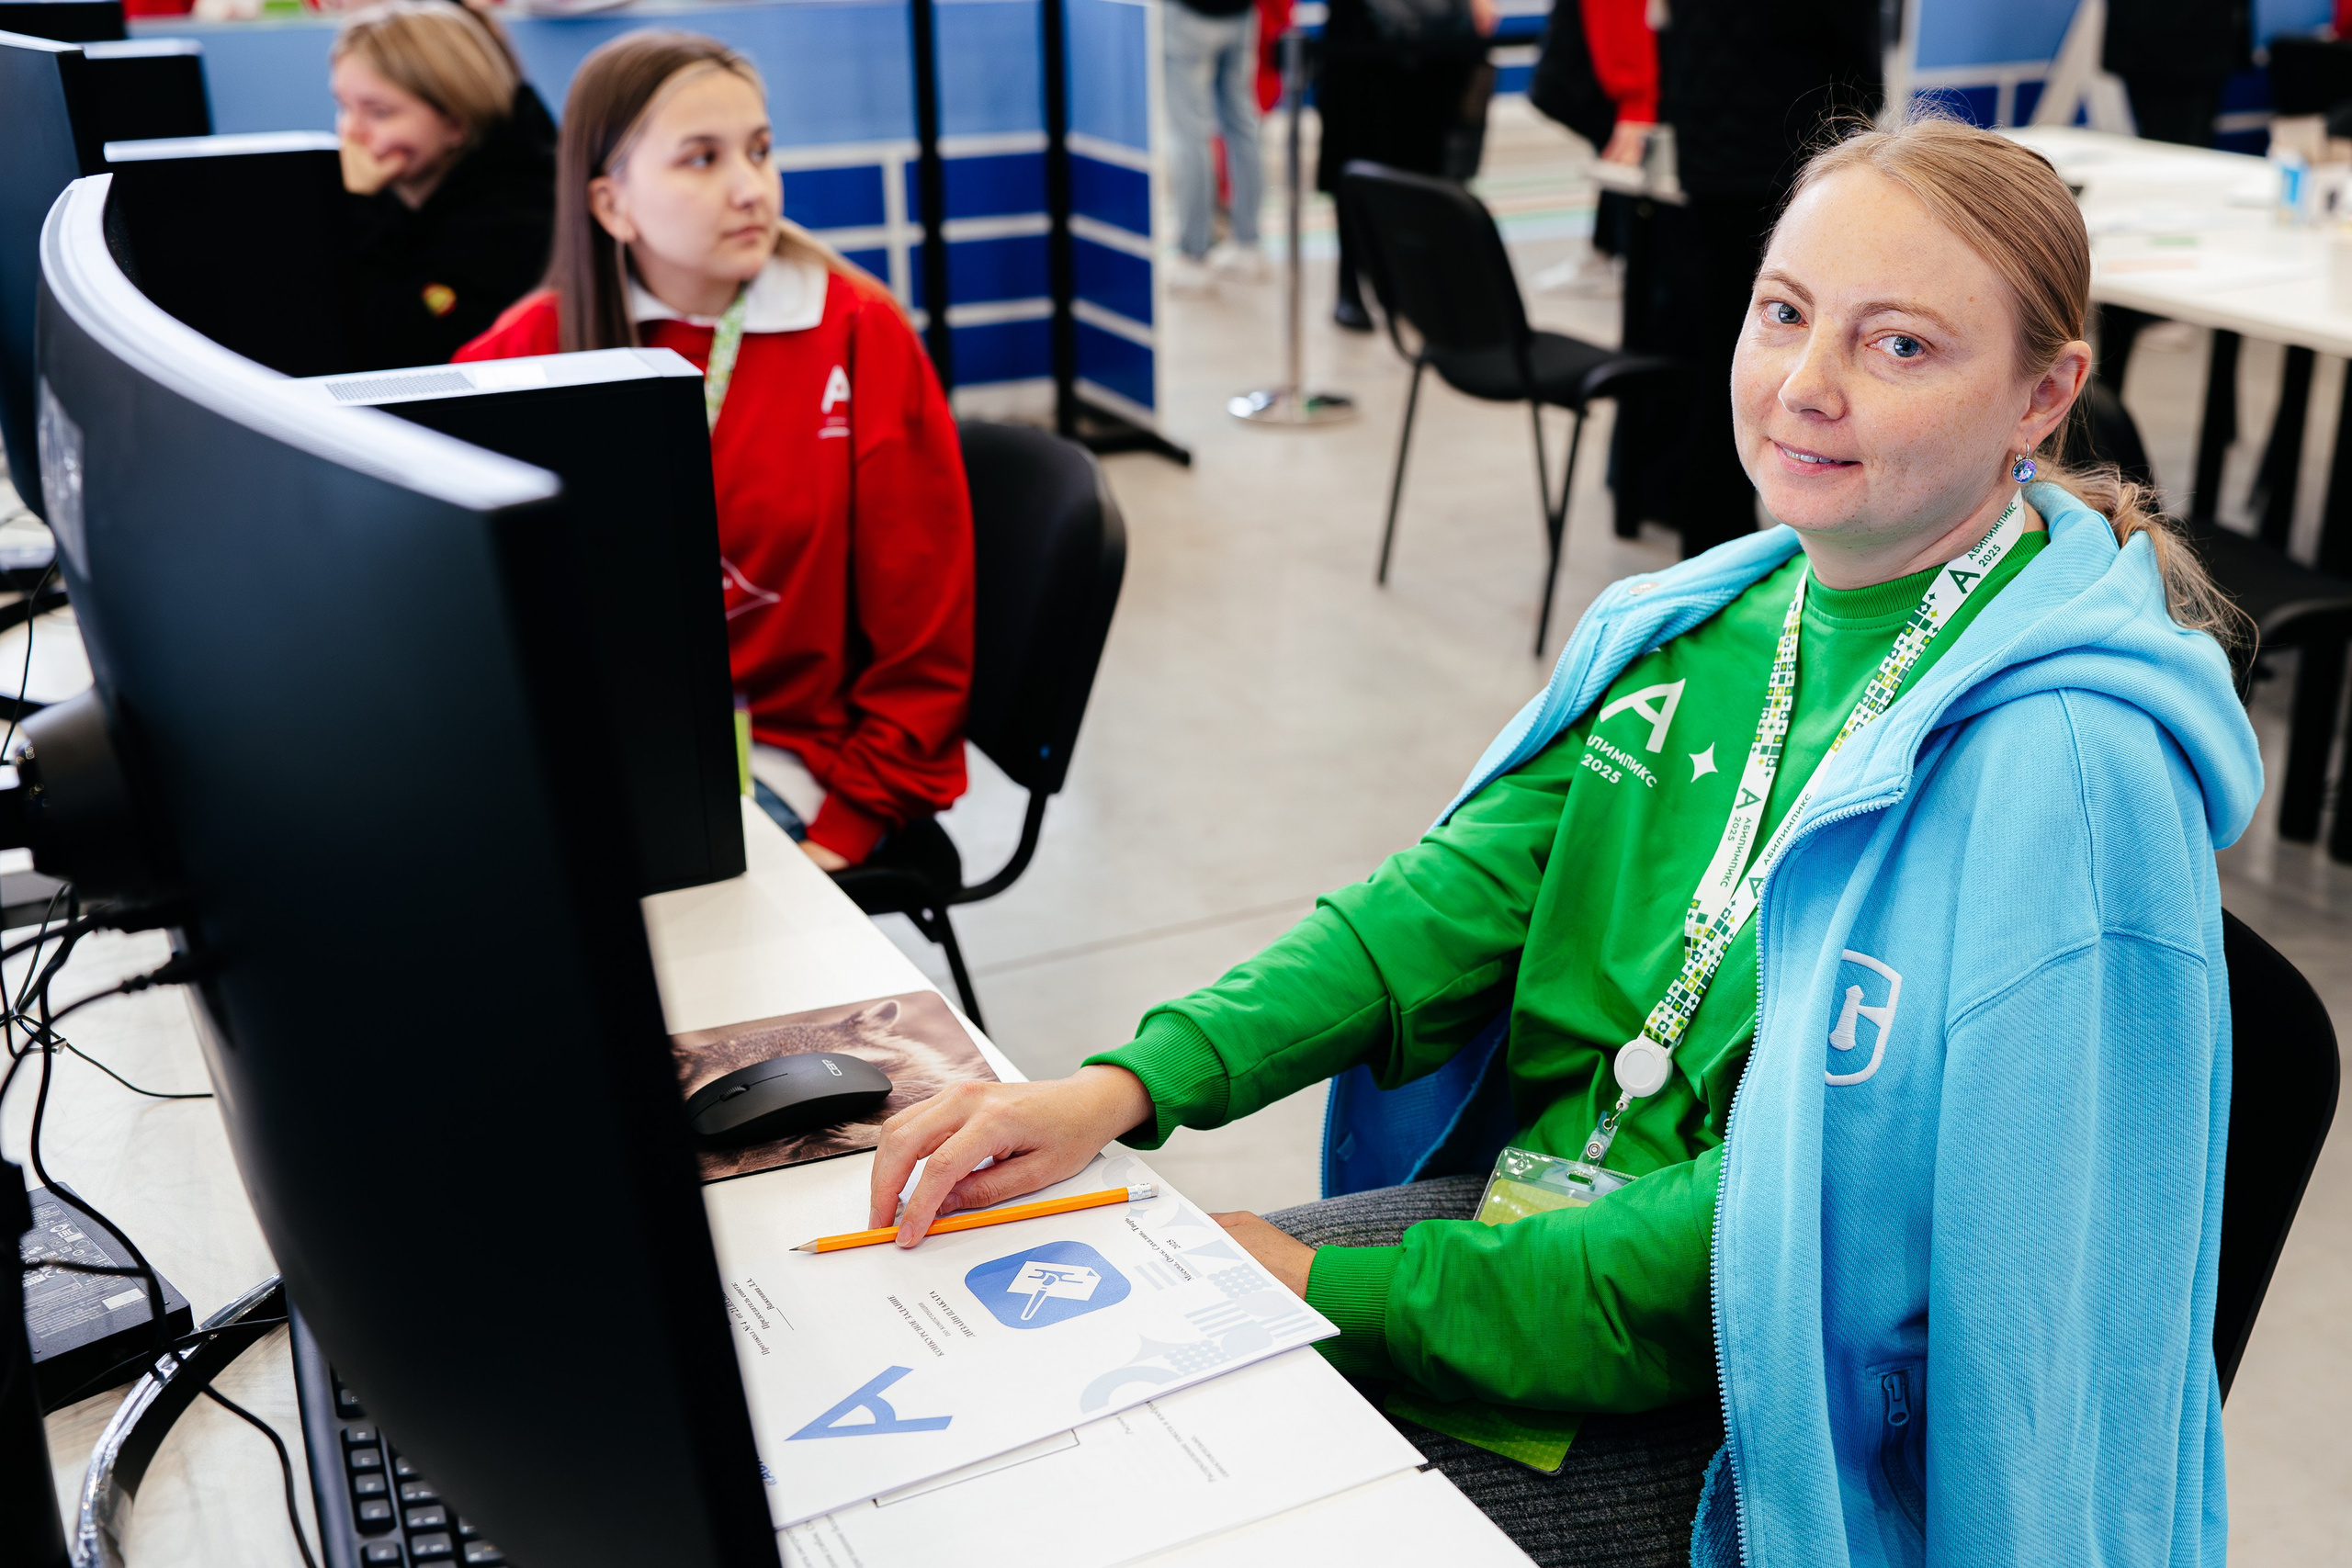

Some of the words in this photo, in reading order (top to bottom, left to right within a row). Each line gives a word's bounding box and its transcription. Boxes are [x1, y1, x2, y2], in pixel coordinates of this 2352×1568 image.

[1967, 502, 2018, 560] АБИЛИМПИКС
[1978, 544, 2001, 568] 2025
[1948, 570, 1981, 594] А
[1600, 678, 1686, 753] А
[1580, 753, 1623, 784] 2025
[1736, 787, 1762, 809] А
[1727, 817, 1742, 841] 2025
[1763, 793, 1812, 866] АБИЛИМПИКС
[1720, 817, 1752, 888] АБИЛИМПИКС
[821, 1059, 842, 1077] CBR
[887, 1295, 912, 1320] ЗАДАНИЕ
[929, 1291, 955, 1317] ПЛАКАТА
[908, 1319, 944, 1357] КОНКУРСНОЕ
[951, 1314, 977, 1337] ДИЗАЙН
